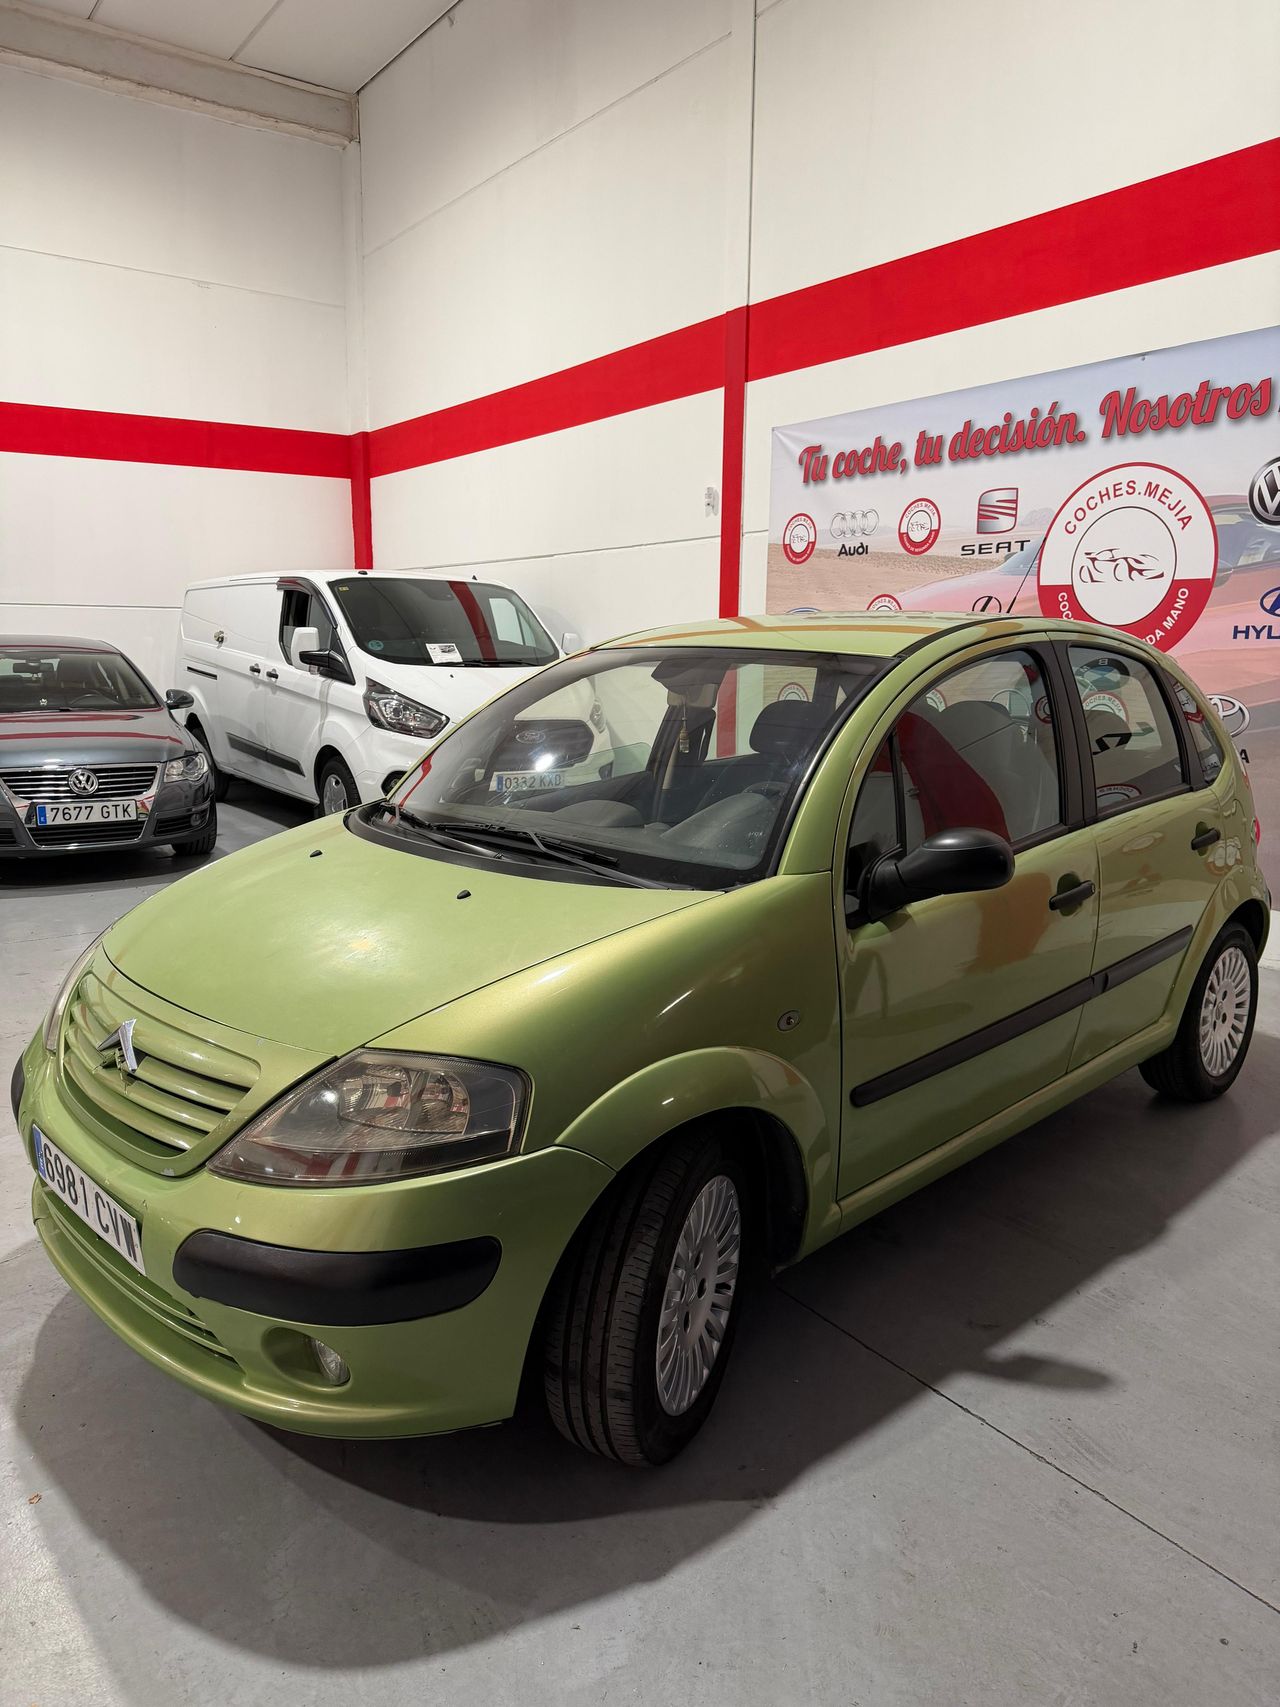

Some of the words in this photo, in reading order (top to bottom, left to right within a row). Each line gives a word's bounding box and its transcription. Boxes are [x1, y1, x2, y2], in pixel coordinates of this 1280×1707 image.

[798, 444, 829, 483] Tu
[832, 436, 907, 479] coche,
[914, 430, 944, 467] tu
[948, 401, 1086, 462] decisión.
[1099, 377, 1272, 438] Nosotros
[838, 542, 869, 557] Audi
[960, 539, 1031, 556] SEAT
[1058, 592, 1074, 621] COC
[1164, 587, 1189, 630] MANO
[50, 806, 94, 823] 7677
[100, 803, 132, 819] GTK
[43, 1142, 90, 1218] 6981
